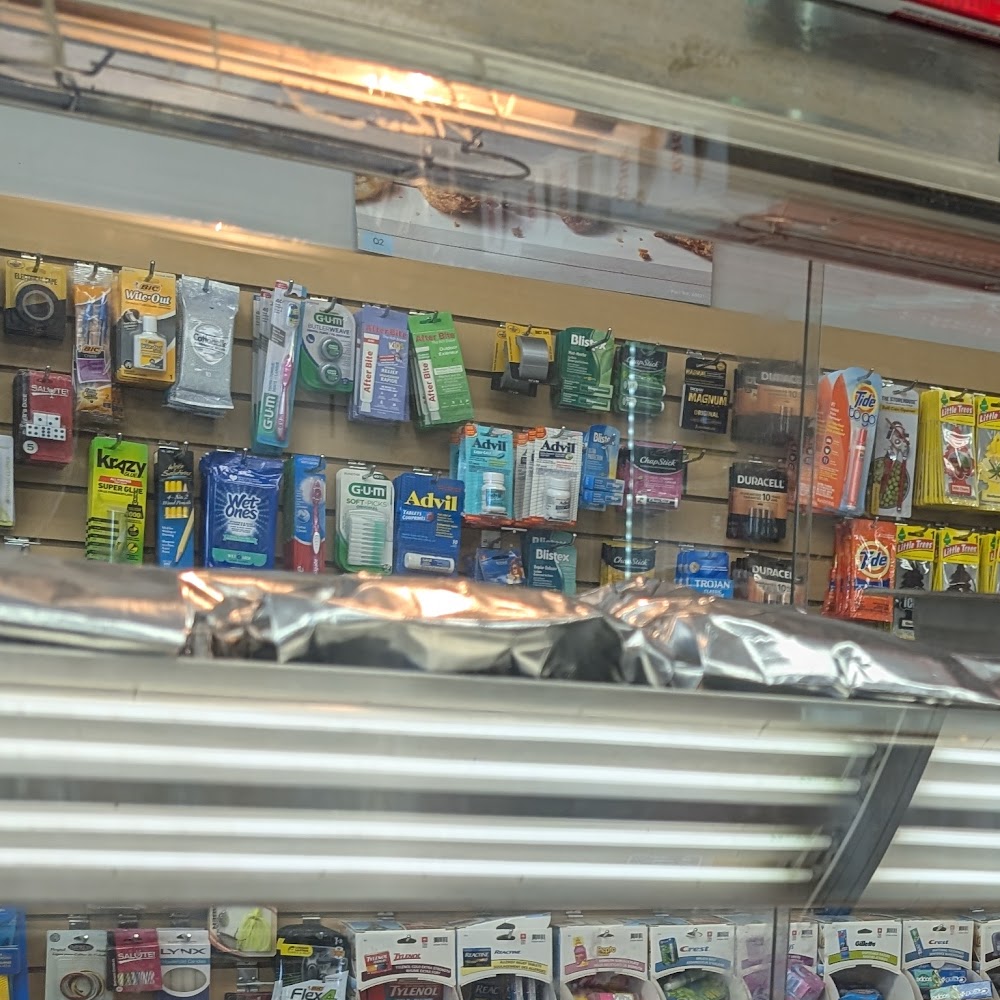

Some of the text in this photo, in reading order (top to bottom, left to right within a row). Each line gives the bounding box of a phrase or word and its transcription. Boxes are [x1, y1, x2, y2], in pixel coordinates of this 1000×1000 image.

[570, 334, 607, 350] Blisx
[688, 392, 728, 407] MAGNUM
[855, 391, 877, 408] Tide
[980, 413, 999, 422] Little
[472, 438, 507, 452] Advil
[540, 440, 575, 453] Advil
[640, 456, 677, 467] ChapStick
[737, 474, 785, 489] DURACELL
[98, 482, 123, 492] SUPER
[124, 484, 144, 495] GLUE
[227, 492, 261, 509] Wet
[404, 490, 458, 511] Advil
[762, 493, 771, 502] 10
[224, 506, 259, 520] Ones
[897, 540, 933, 552] Little Trees
[535, 549, 570, 562] Blistex
[613, 556, 648, 566] ChaStick
[860, 551, 888, 569] Tde
[752, 565, 792, 580] DURACE
[695, 580, 731, 589] TROJAN
[390, 985, 438, 997] TYLENOL
